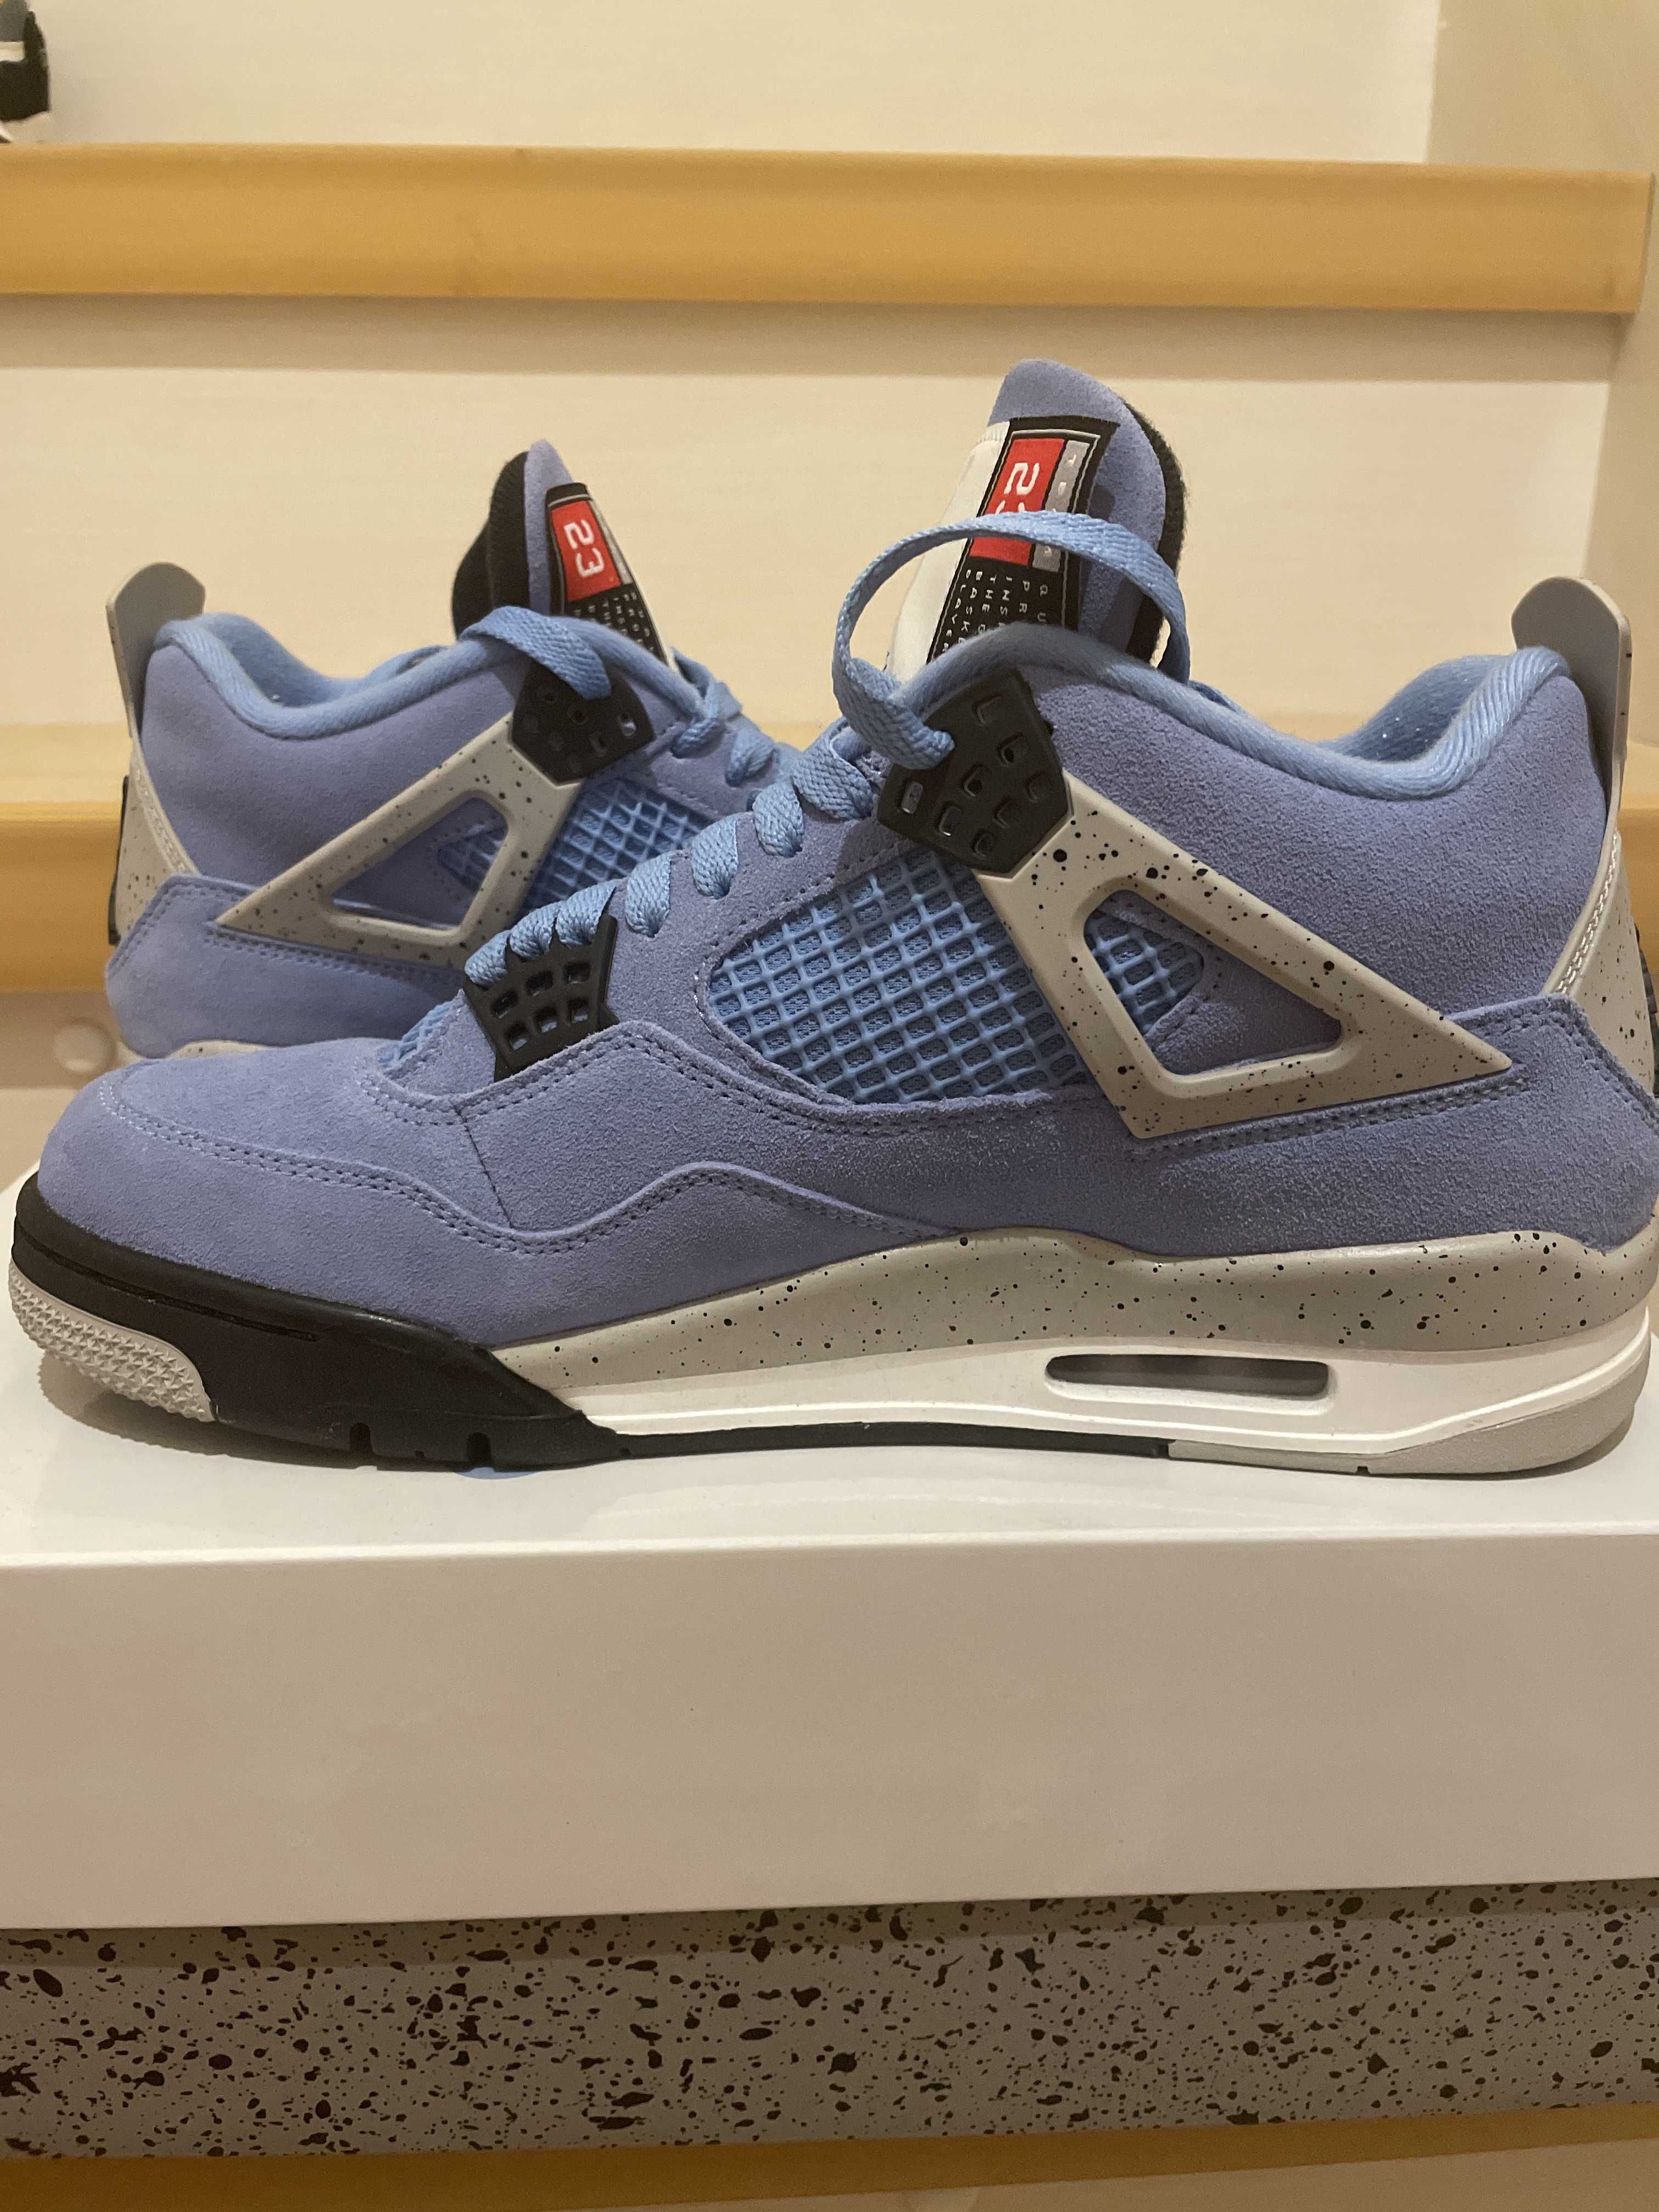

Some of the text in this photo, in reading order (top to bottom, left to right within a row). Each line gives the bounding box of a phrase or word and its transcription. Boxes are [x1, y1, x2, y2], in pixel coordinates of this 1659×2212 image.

[995, 462, 1040, 514] 2
[563, 519, 606, 578] 23
[958, 571, 983, 645] BASK
[1019, 580, 1030, 614] PR
[1036, 583, 1048, 623] QU
